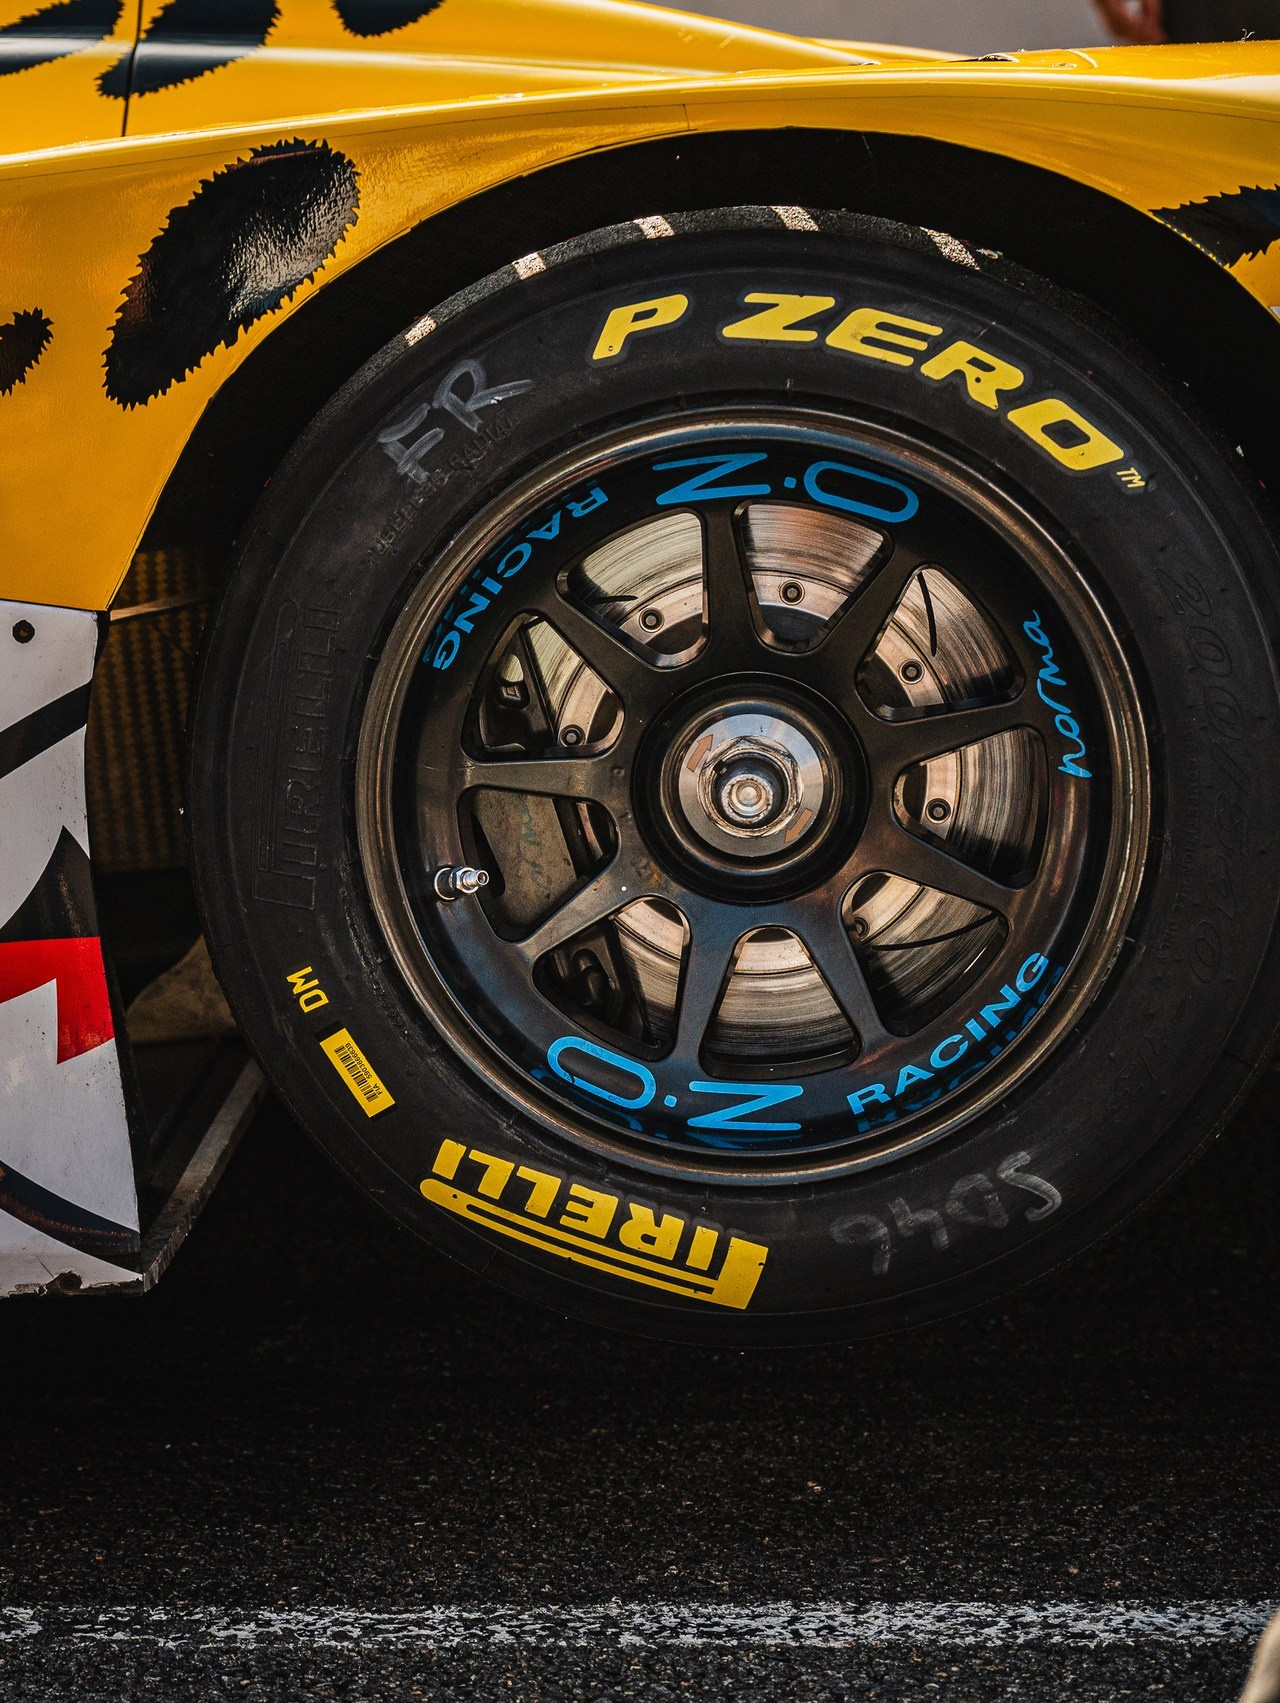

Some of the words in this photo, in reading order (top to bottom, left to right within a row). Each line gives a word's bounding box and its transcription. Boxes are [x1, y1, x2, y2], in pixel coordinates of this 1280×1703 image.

[593, 293, 689, 361] P
[376, 358, 534, 482] FR
[433, 481, 609, 671] RACING
[286, 966, 329, 1013] DM
[846, 950, 1049, 1116] RACING
[372, 1083, 383, 1096] FIA
[420, 1139, 769, 1311] PIRELLI
